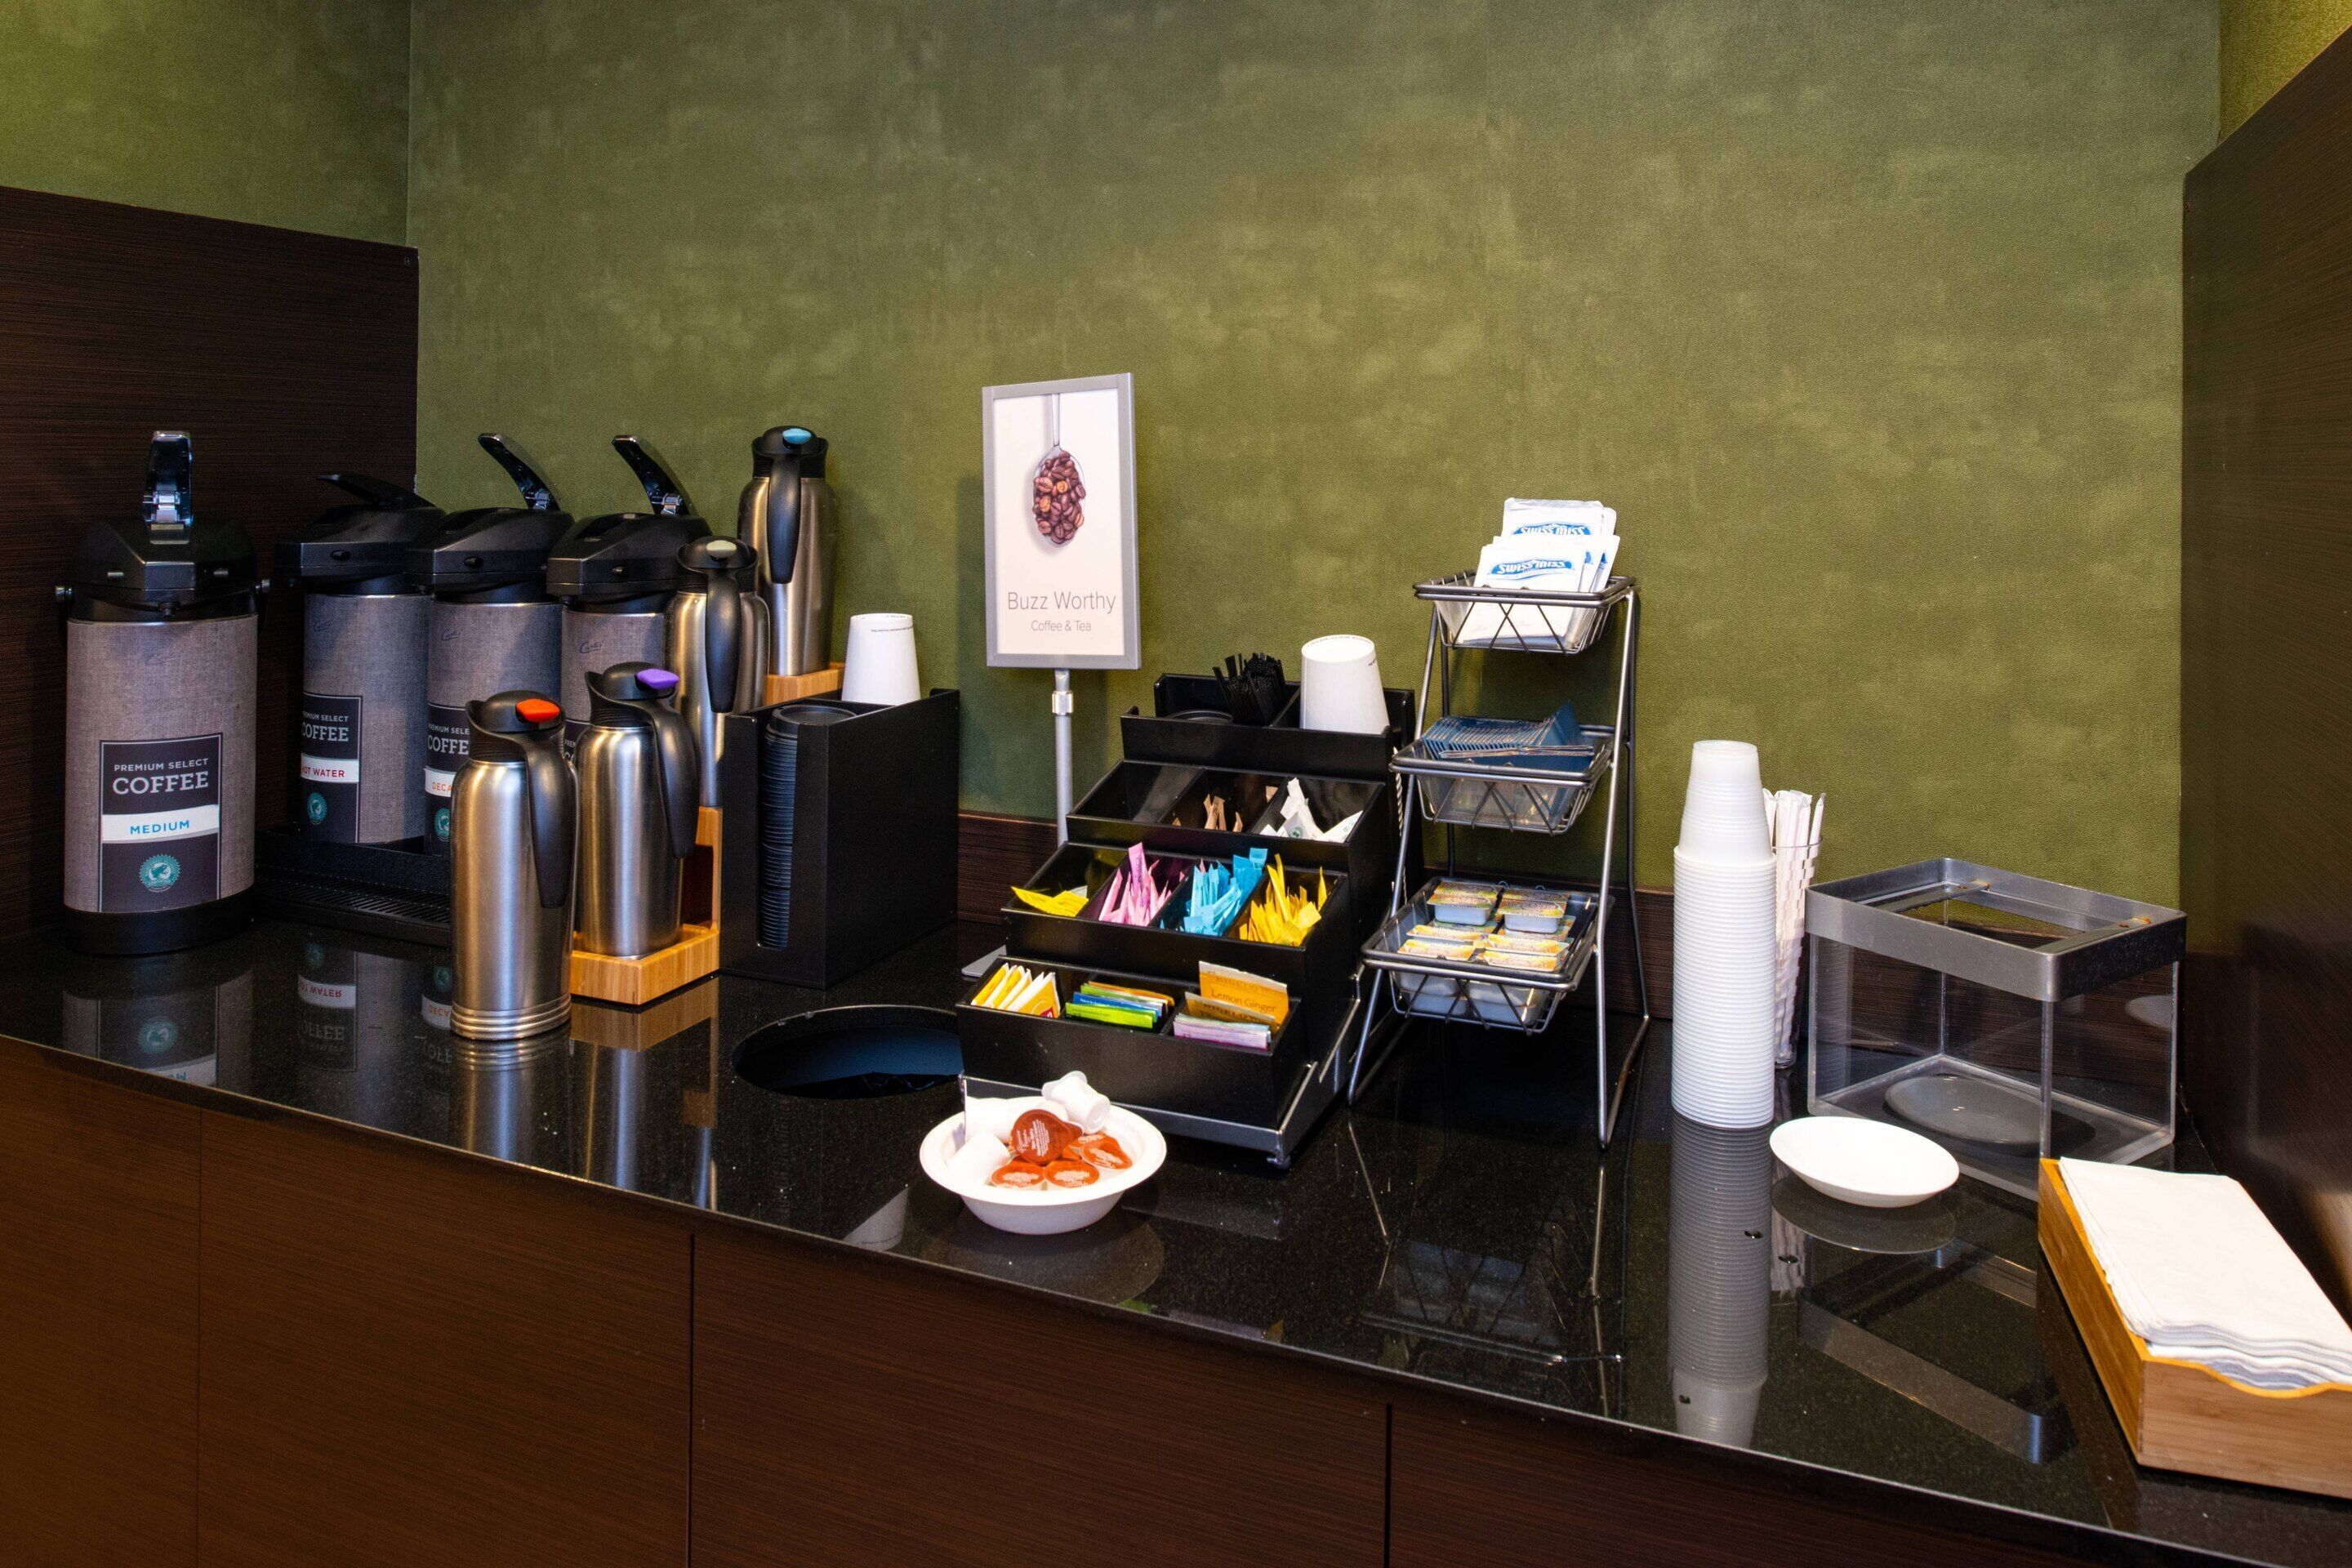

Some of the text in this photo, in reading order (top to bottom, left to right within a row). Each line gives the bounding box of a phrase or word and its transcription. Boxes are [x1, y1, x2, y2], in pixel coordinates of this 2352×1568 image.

[1008, 591, 1116, 614] Buzz Worthy
[1031, 620, 1092, 631] Coffee & Tea
[321, 715, 350, 723] SELECT
[302, 722, 349, 742] COFFEE
[427, 734, 470, 755] COFFE
[114, 758, 209, 772] PREMIUM SELECT
[313, 768, 345, 778] WATER
[113, 771, 209, 795] COFFEE
[432, 782, 453, 792] DECA
[131, 820, 189, 835] MEDIUM
[1211, 988, 1276, 1013] Lemon Ginger
